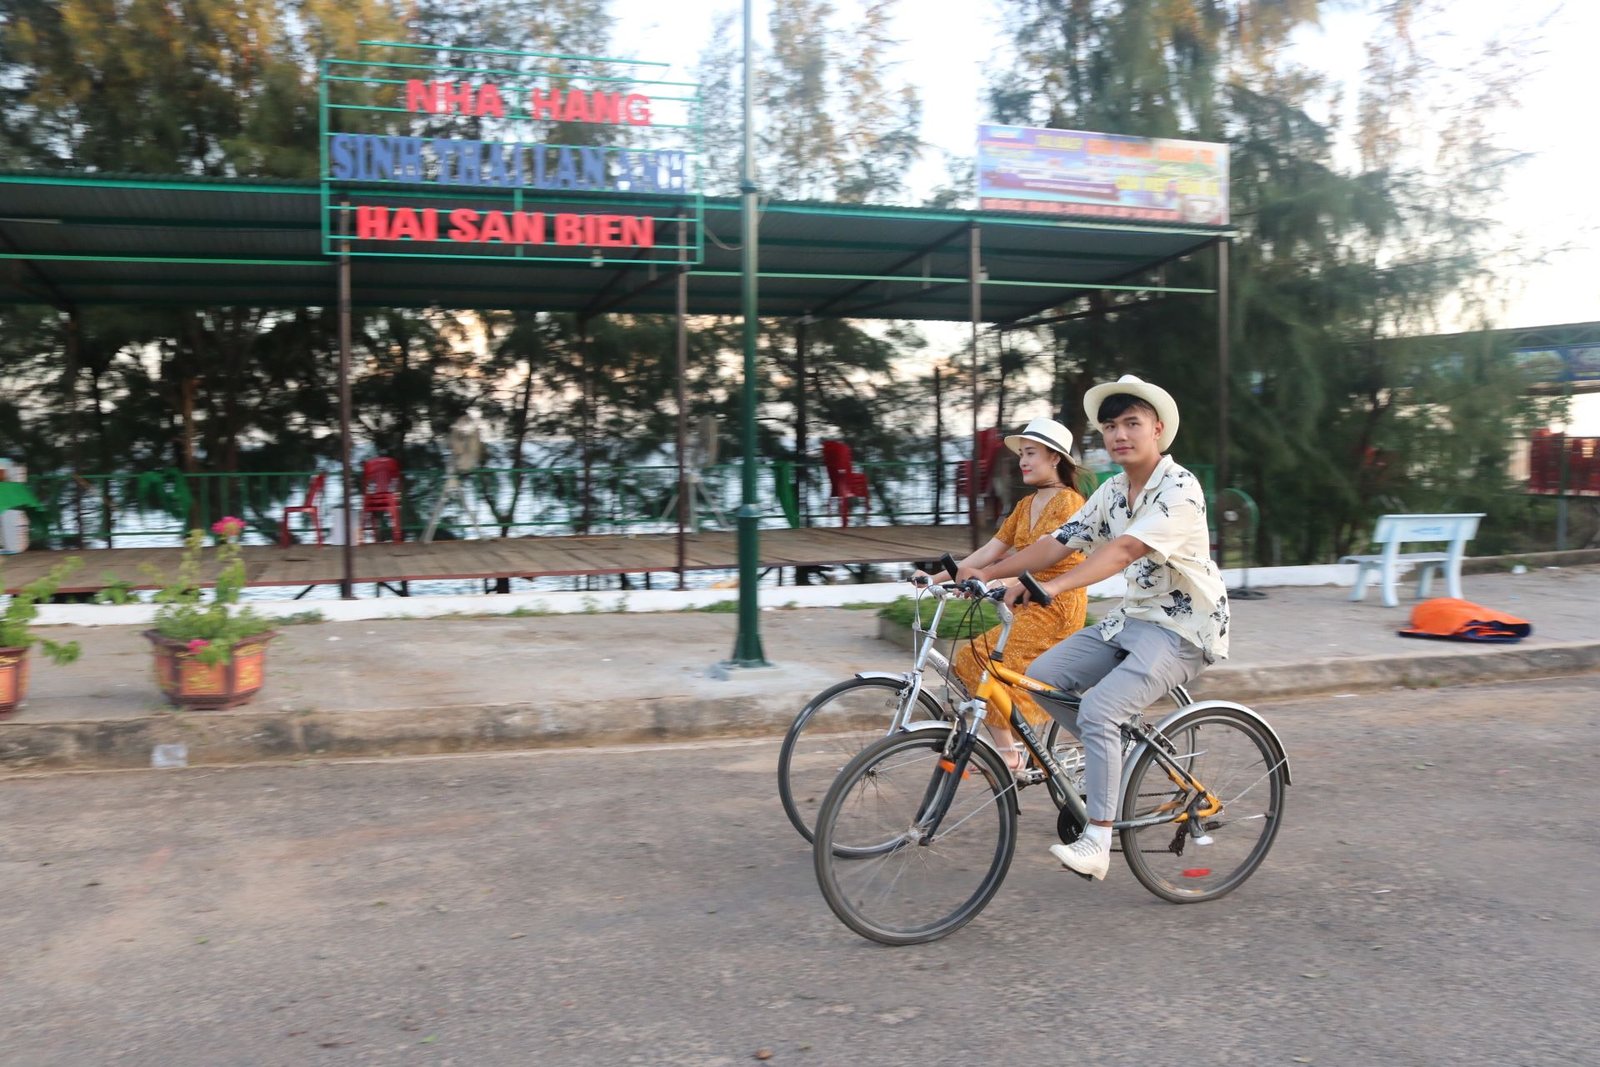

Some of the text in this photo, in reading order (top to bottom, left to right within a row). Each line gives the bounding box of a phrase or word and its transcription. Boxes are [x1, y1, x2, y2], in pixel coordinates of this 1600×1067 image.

[406, 79, 652, 126] NHA HANG
[331, 133, 423, 184] SINH
[356, 204, 655, 249] HAI SAN BIEN
